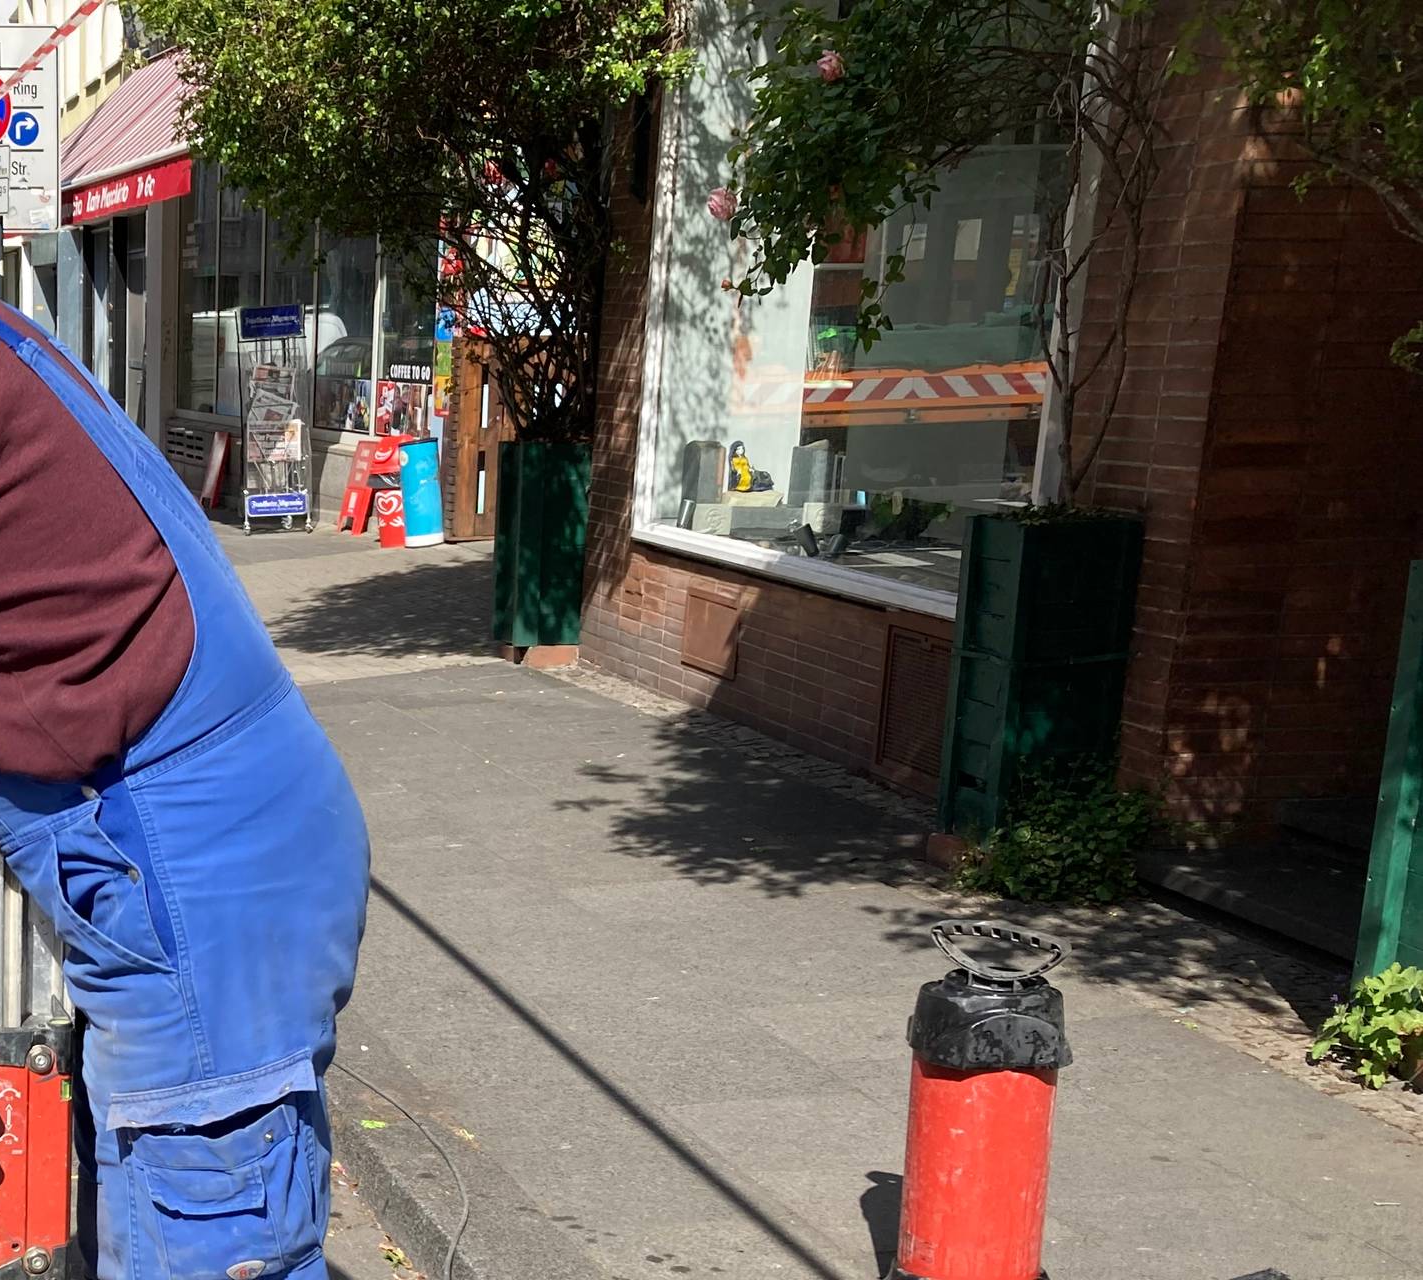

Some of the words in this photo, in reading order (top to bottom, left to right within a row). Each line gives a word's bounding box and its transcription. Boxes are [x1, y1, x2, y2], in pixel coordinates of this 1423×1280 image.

[13, 80, 37, 99] Ring
[390, 364, 411, 379] COFFEE
[412, 365, 420, 380] TO
[421, 366, 431, 381] GO
